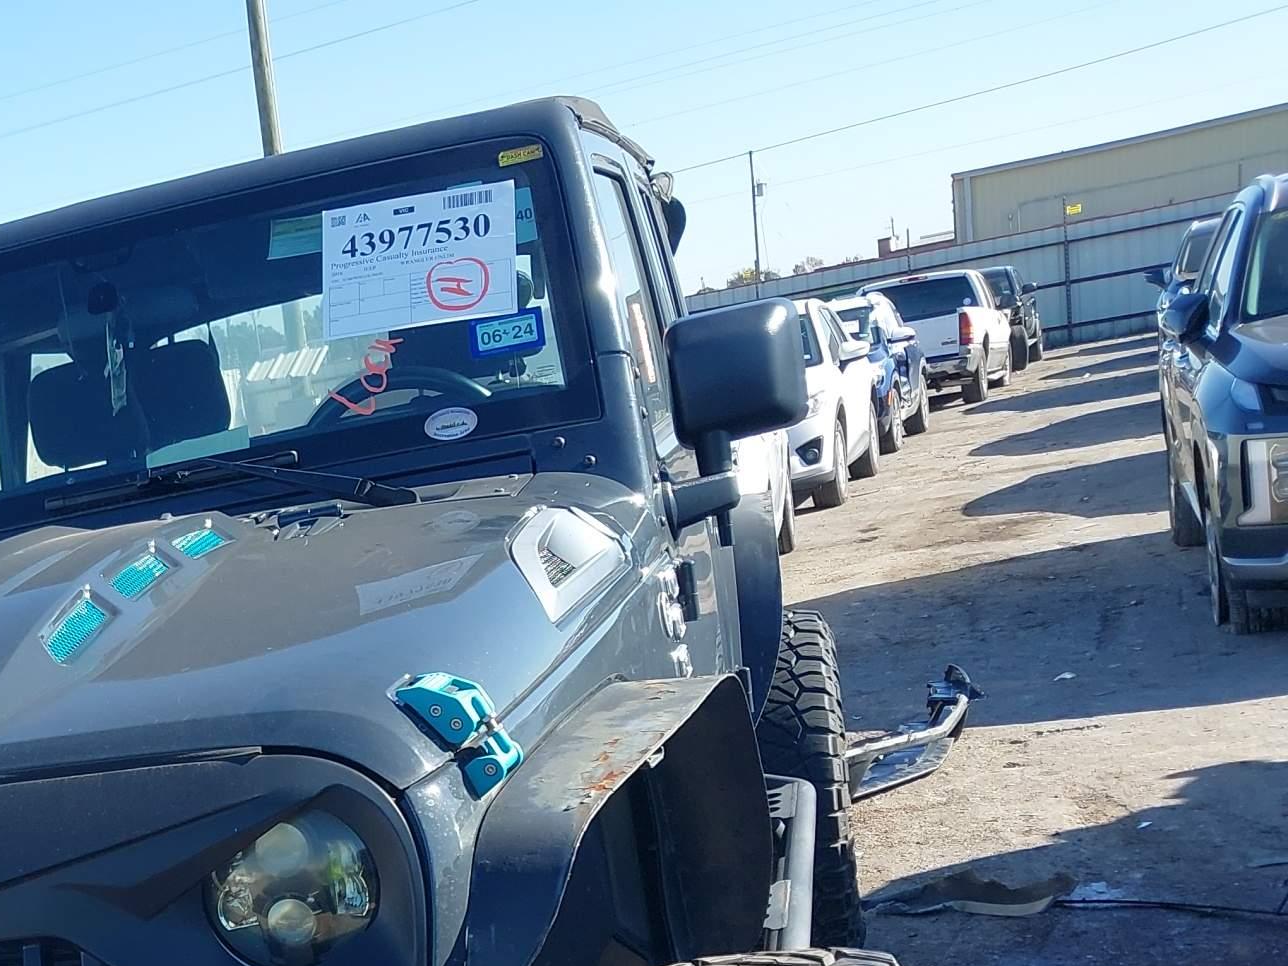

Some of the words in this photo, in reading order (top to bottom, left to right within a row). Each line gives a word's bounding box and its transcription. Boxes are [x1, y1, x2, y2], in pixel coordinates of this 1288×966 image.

[341, 213, 491, 259] 43977530
[330, 257, 374, 271] Progressive
[376, 251, 409, 263] Casualty
[411, 246, 449, 257] Insurance
[480, 328, 503, 346] 06
[511, 322, 535, 340] 24
